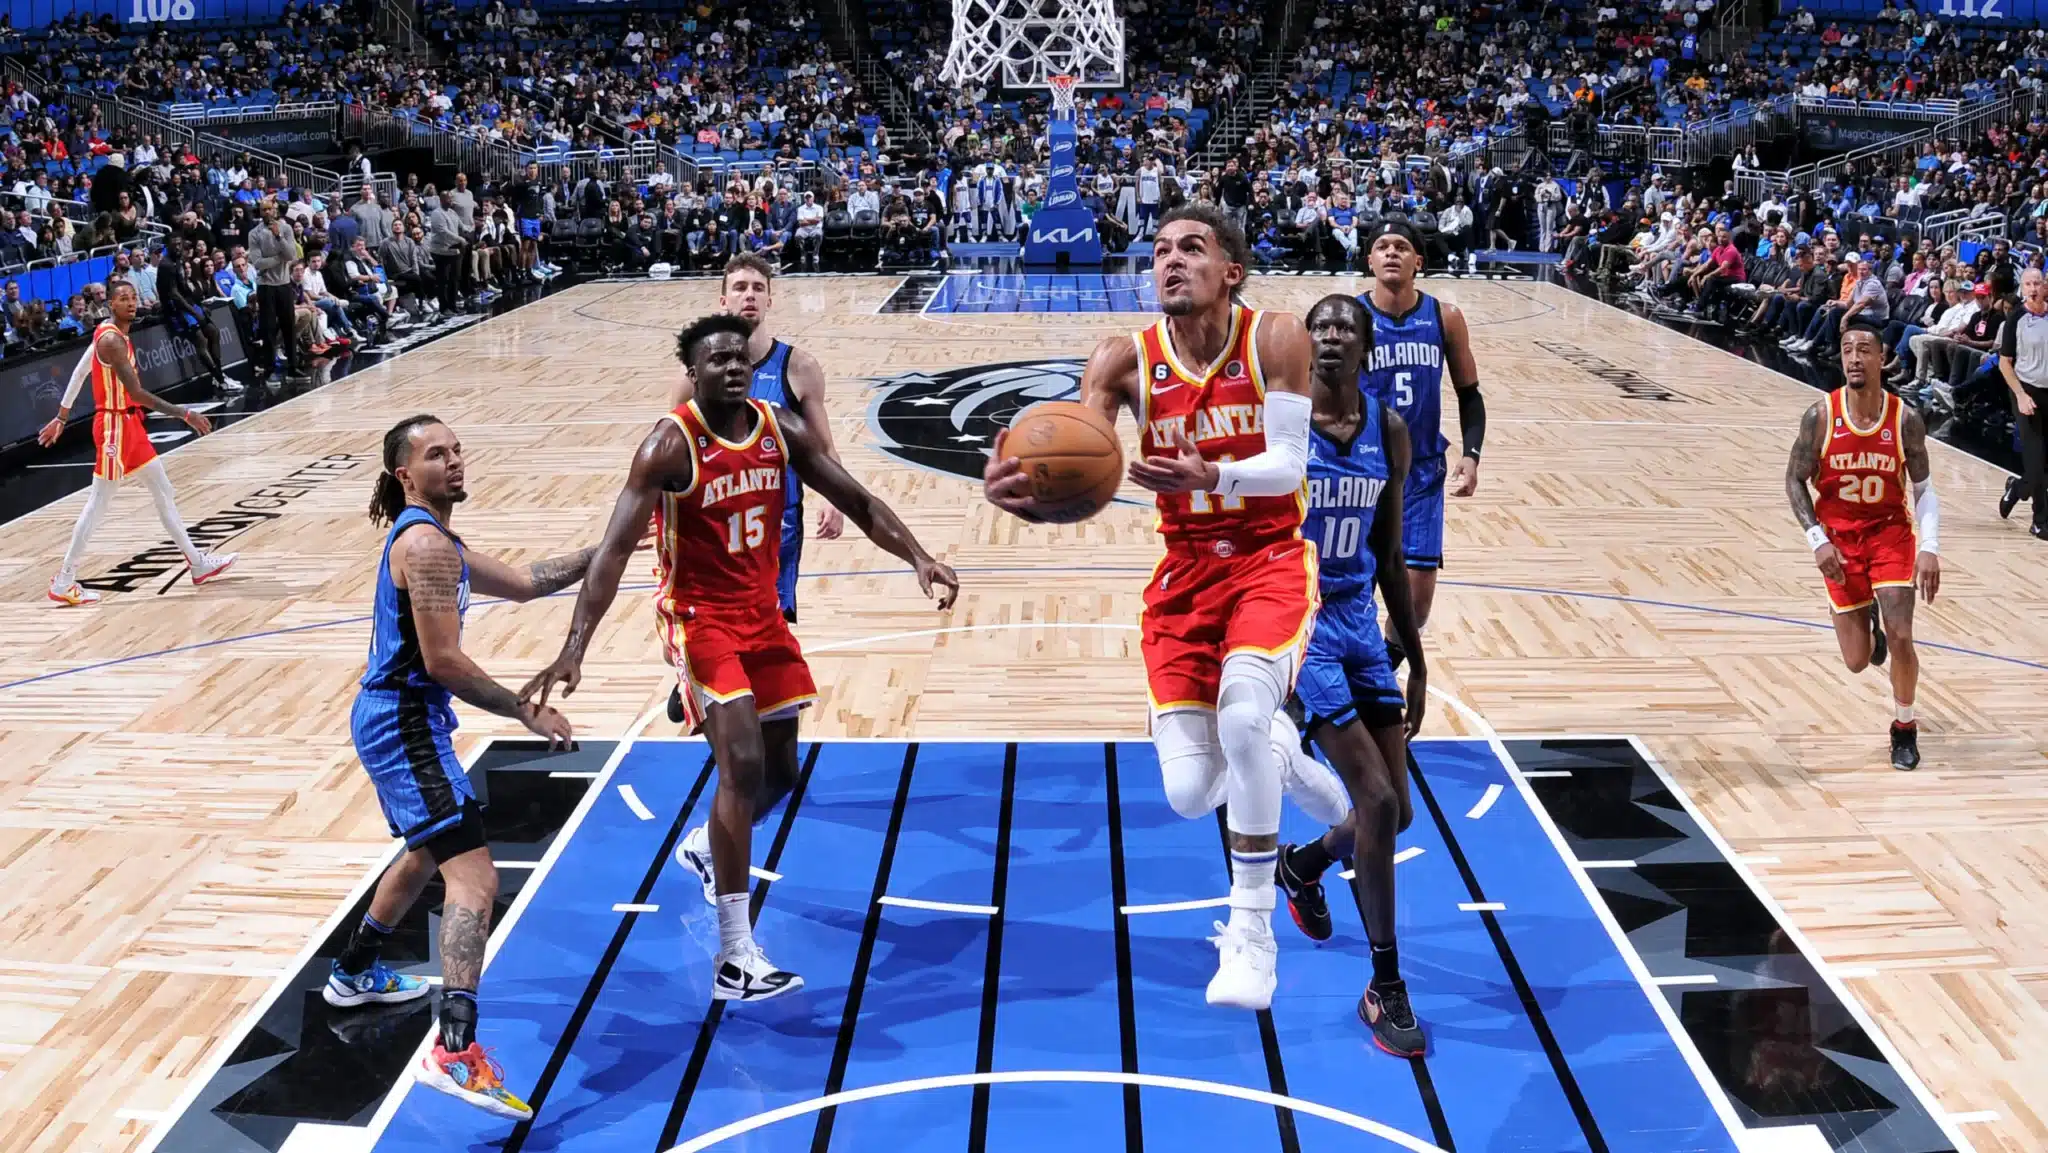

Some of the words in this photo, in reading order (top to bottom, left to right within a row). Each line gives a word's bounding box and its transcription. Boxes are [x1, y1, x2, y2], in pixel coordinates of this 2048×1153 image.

[1155, 363, 1168, 380] 6
[1394, 372, 1414, 407] 5
[698, 436, 707, 448] 6
[1829, 452, 1896, 473] ATLANTA
[233, 452, 376, 510] CENTER
[701, 467, 781, 508] ATLANTA
[1308, 476, 1386, 509] RLAND
[1838, 474, 1885, 504] 20
[727, 504, 766, 553] 15
[1321, 516, 1361, 559] 10
